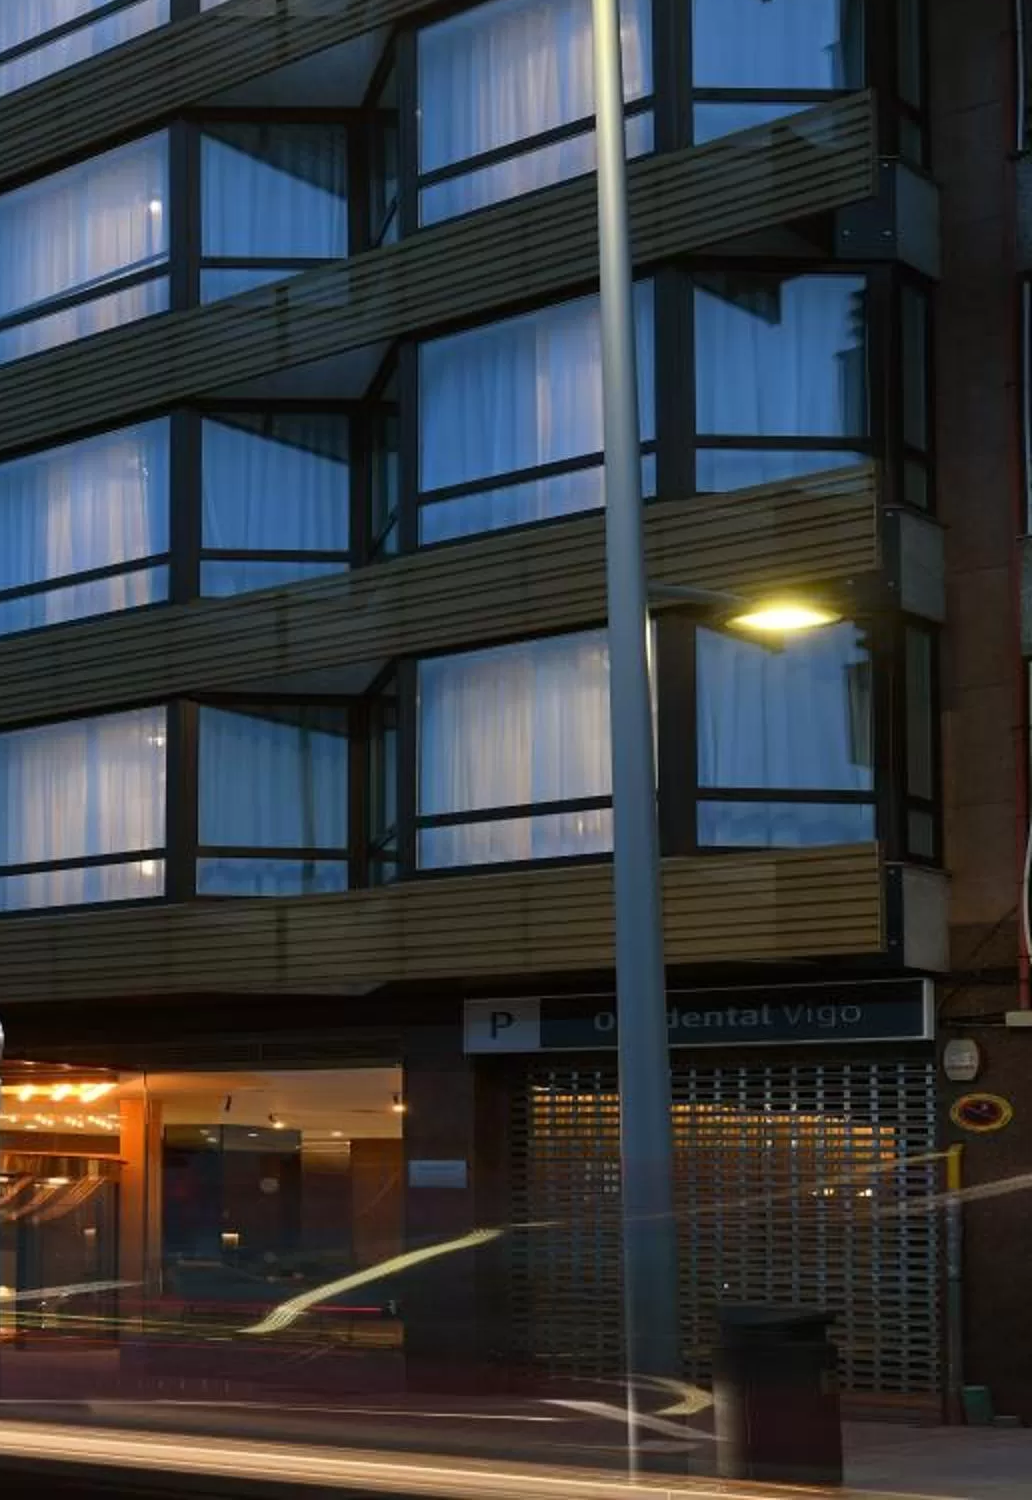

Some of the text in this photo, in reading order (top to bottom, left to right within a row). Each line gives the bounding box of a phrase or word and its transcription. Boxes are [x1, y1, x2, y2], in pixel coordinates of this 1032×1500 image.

[489, 1011, 514, 1040] P
[593, 1002, 862, 1032] Odental Vigo
